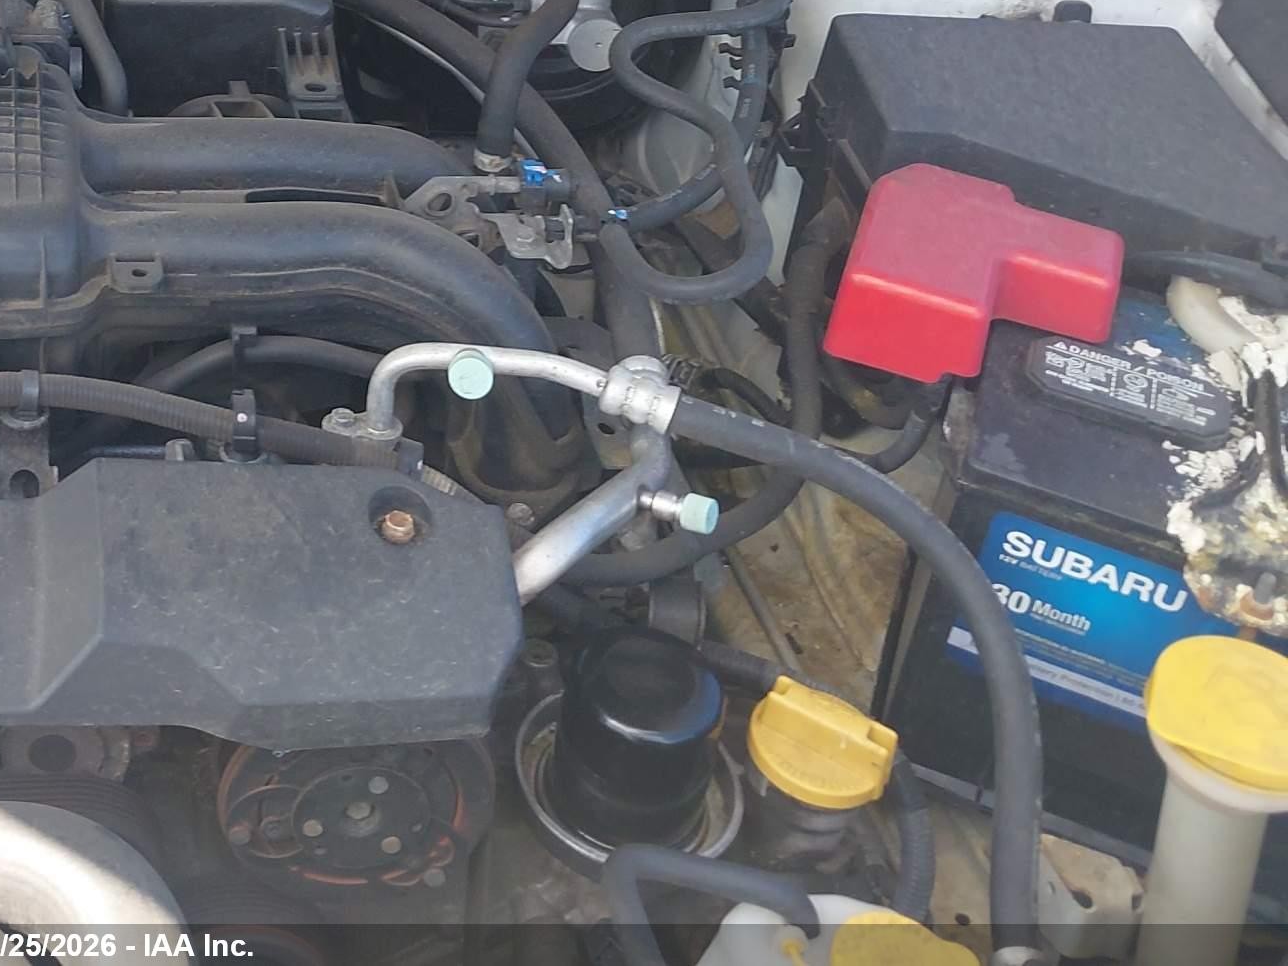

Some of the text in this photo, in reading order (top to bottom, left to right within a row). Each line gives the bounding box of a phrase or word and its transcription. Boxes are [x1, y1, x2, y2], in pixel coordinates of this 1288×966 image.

[1069, 345, 1132, 370] DANGER
[1146, 368, 1204, 392] POISON
[1001, 530, 1188, 612] SUBARU
[1031, 599, 1092, 632] Month
